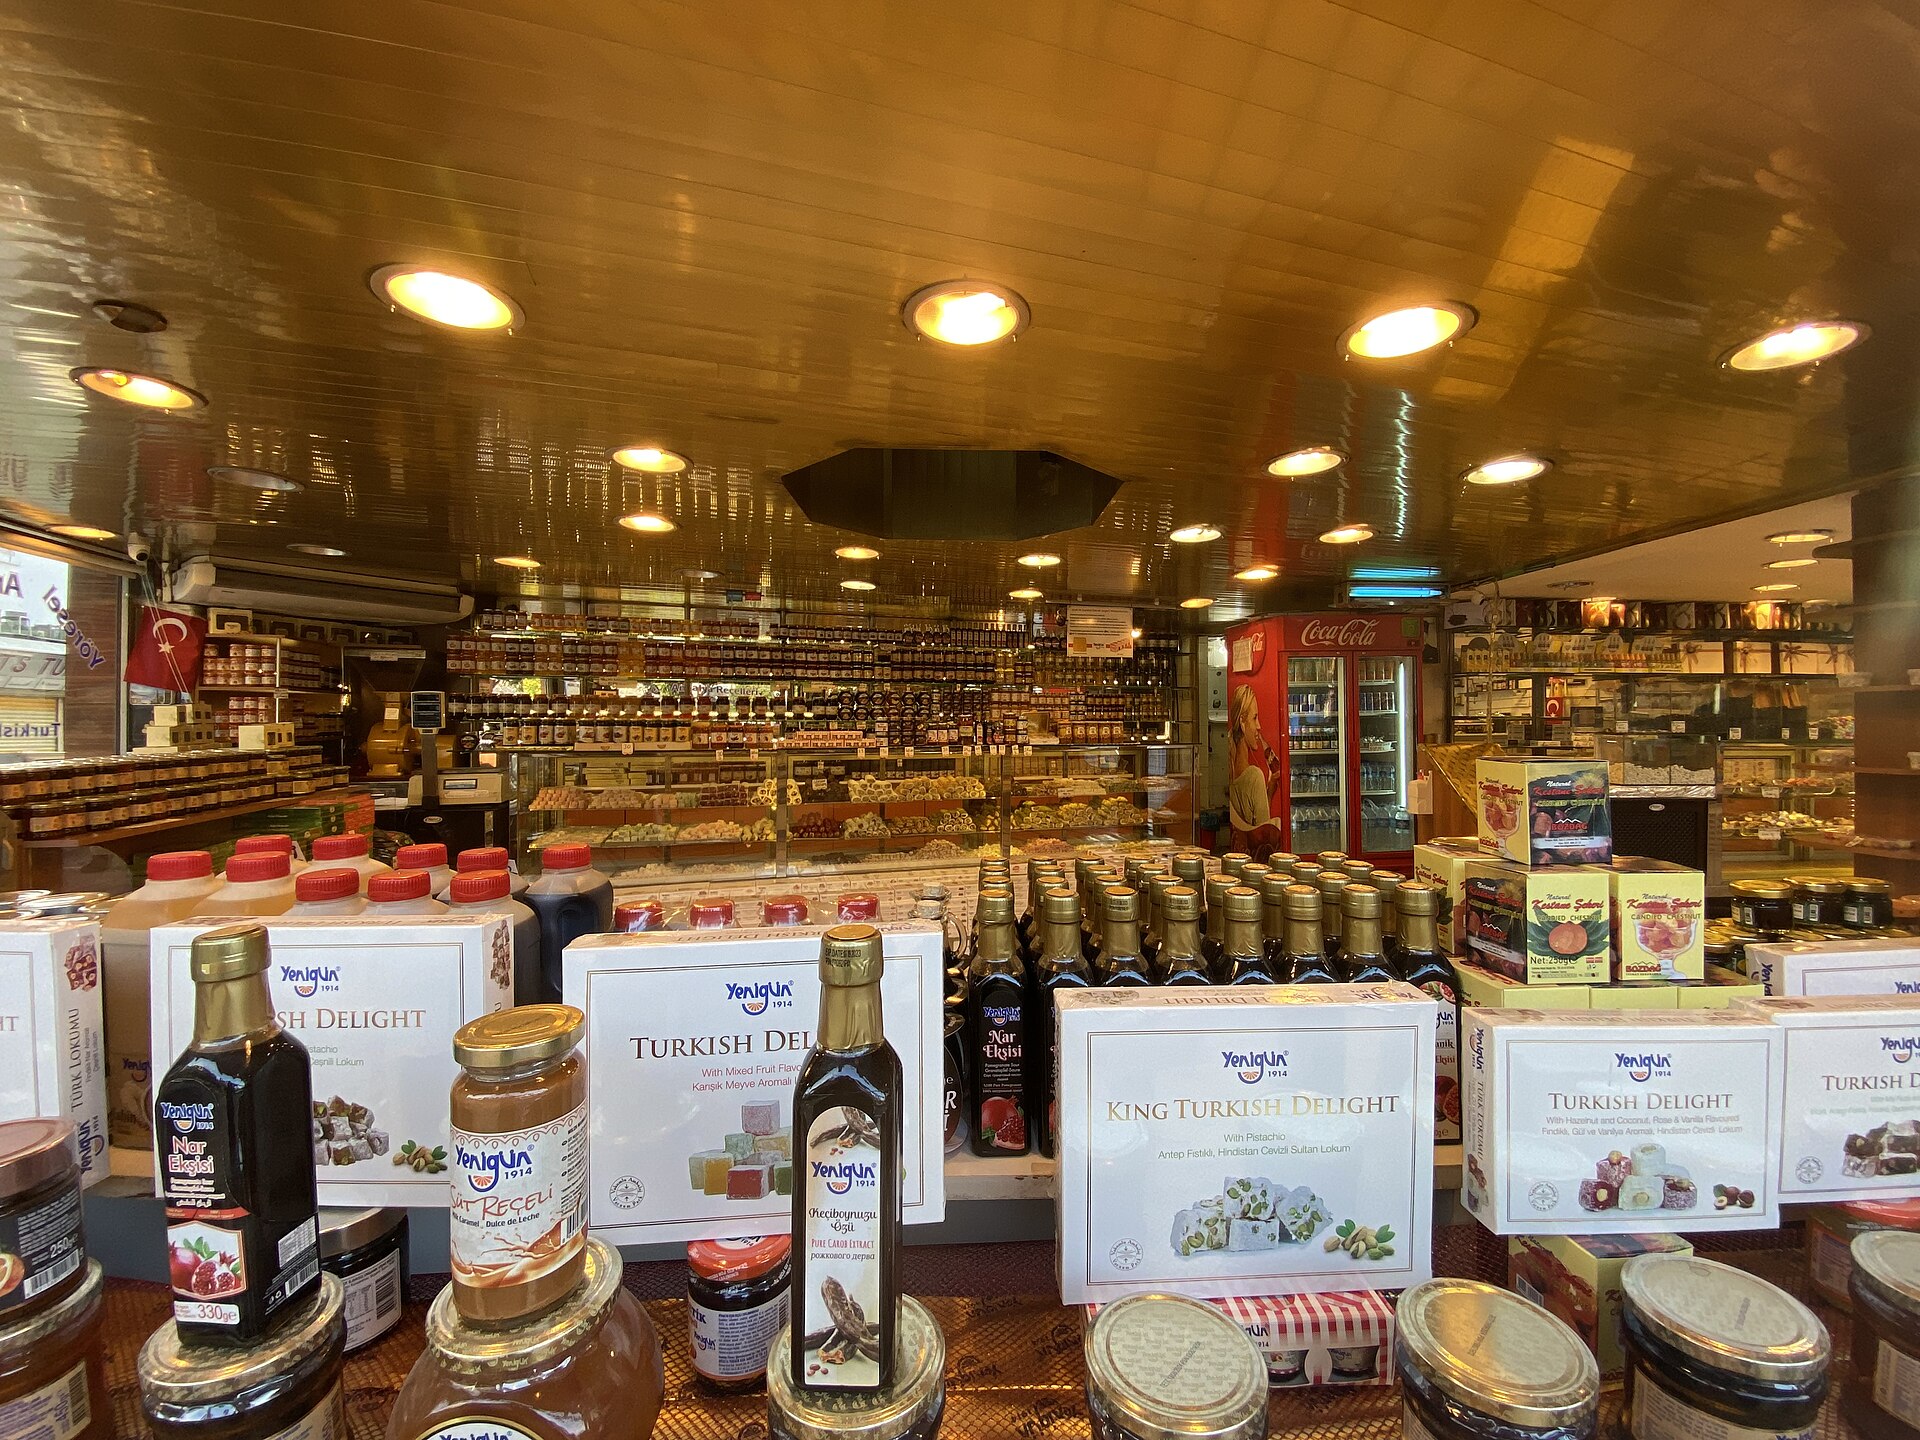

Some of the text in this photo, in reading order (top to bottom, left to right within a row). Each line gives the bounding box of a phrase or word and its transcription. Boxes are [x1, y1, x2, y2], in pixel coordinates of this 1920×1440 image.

[1301, 618, 1380, 647] Coca-Cola
[772, 1000, 792, 1008] 1914
[278, 1008, 426, 1029] SH DELIGHT
[988, 1029, 1016, 1044] Nar
[1435, 1039, 1455, 1049] anik
[305, 1045, 338, 1054] stachio
[630, 1029, 811, 1060] TURKISH DEL
[68, 1008, 83, 1112] TÜRK LOKUMU
[335, 1057, 364, 1066] Lokum
[701, 1062, 802, 1077] With Mixed Fruit Flavo
[1267, 1070, 1287, 1078] 1914
[724, 1078, 755, 1091] Meyve
[1822, 1075, 1902, 1091] TURKISH
[1106, 1094, 1401, 1121] KING TURKISH DELIGHT
[1548, 1092, 1733, 1110] TURKISH DELIGHT
[196, 1121, 214, 1130] 1914
[1546, 1116, 1564, 1124] With
[1565, 1116, 1599, 1124] Hazelnut
[1600, 1116, 1615, 1124] and
[1652, 1116, 1673, 1124] Rose
[1223, 1133, 1286, 1142] With Pistachio
[172, 1136, 206, 1155] Nar
[1158, 1150, 1185, 1160] Antep
[1218, 1147, 1259, 1156] Hindistan
[1260, 1146, 1289, 1155] Cevizli
[1290, 1145, 1318, 1154] Sultan
[1320, 1144, 1351, 1153] Lokum
[504, 1167, 533, 1180] 1914
[459, 1215, 480, 1227] Caramel
[486, 1220, 506, 1228] Dulce
[518, 1212, 540, 1224] Leche
[811, 1238, 874, 1249] PURE CAROB EXTRACT
